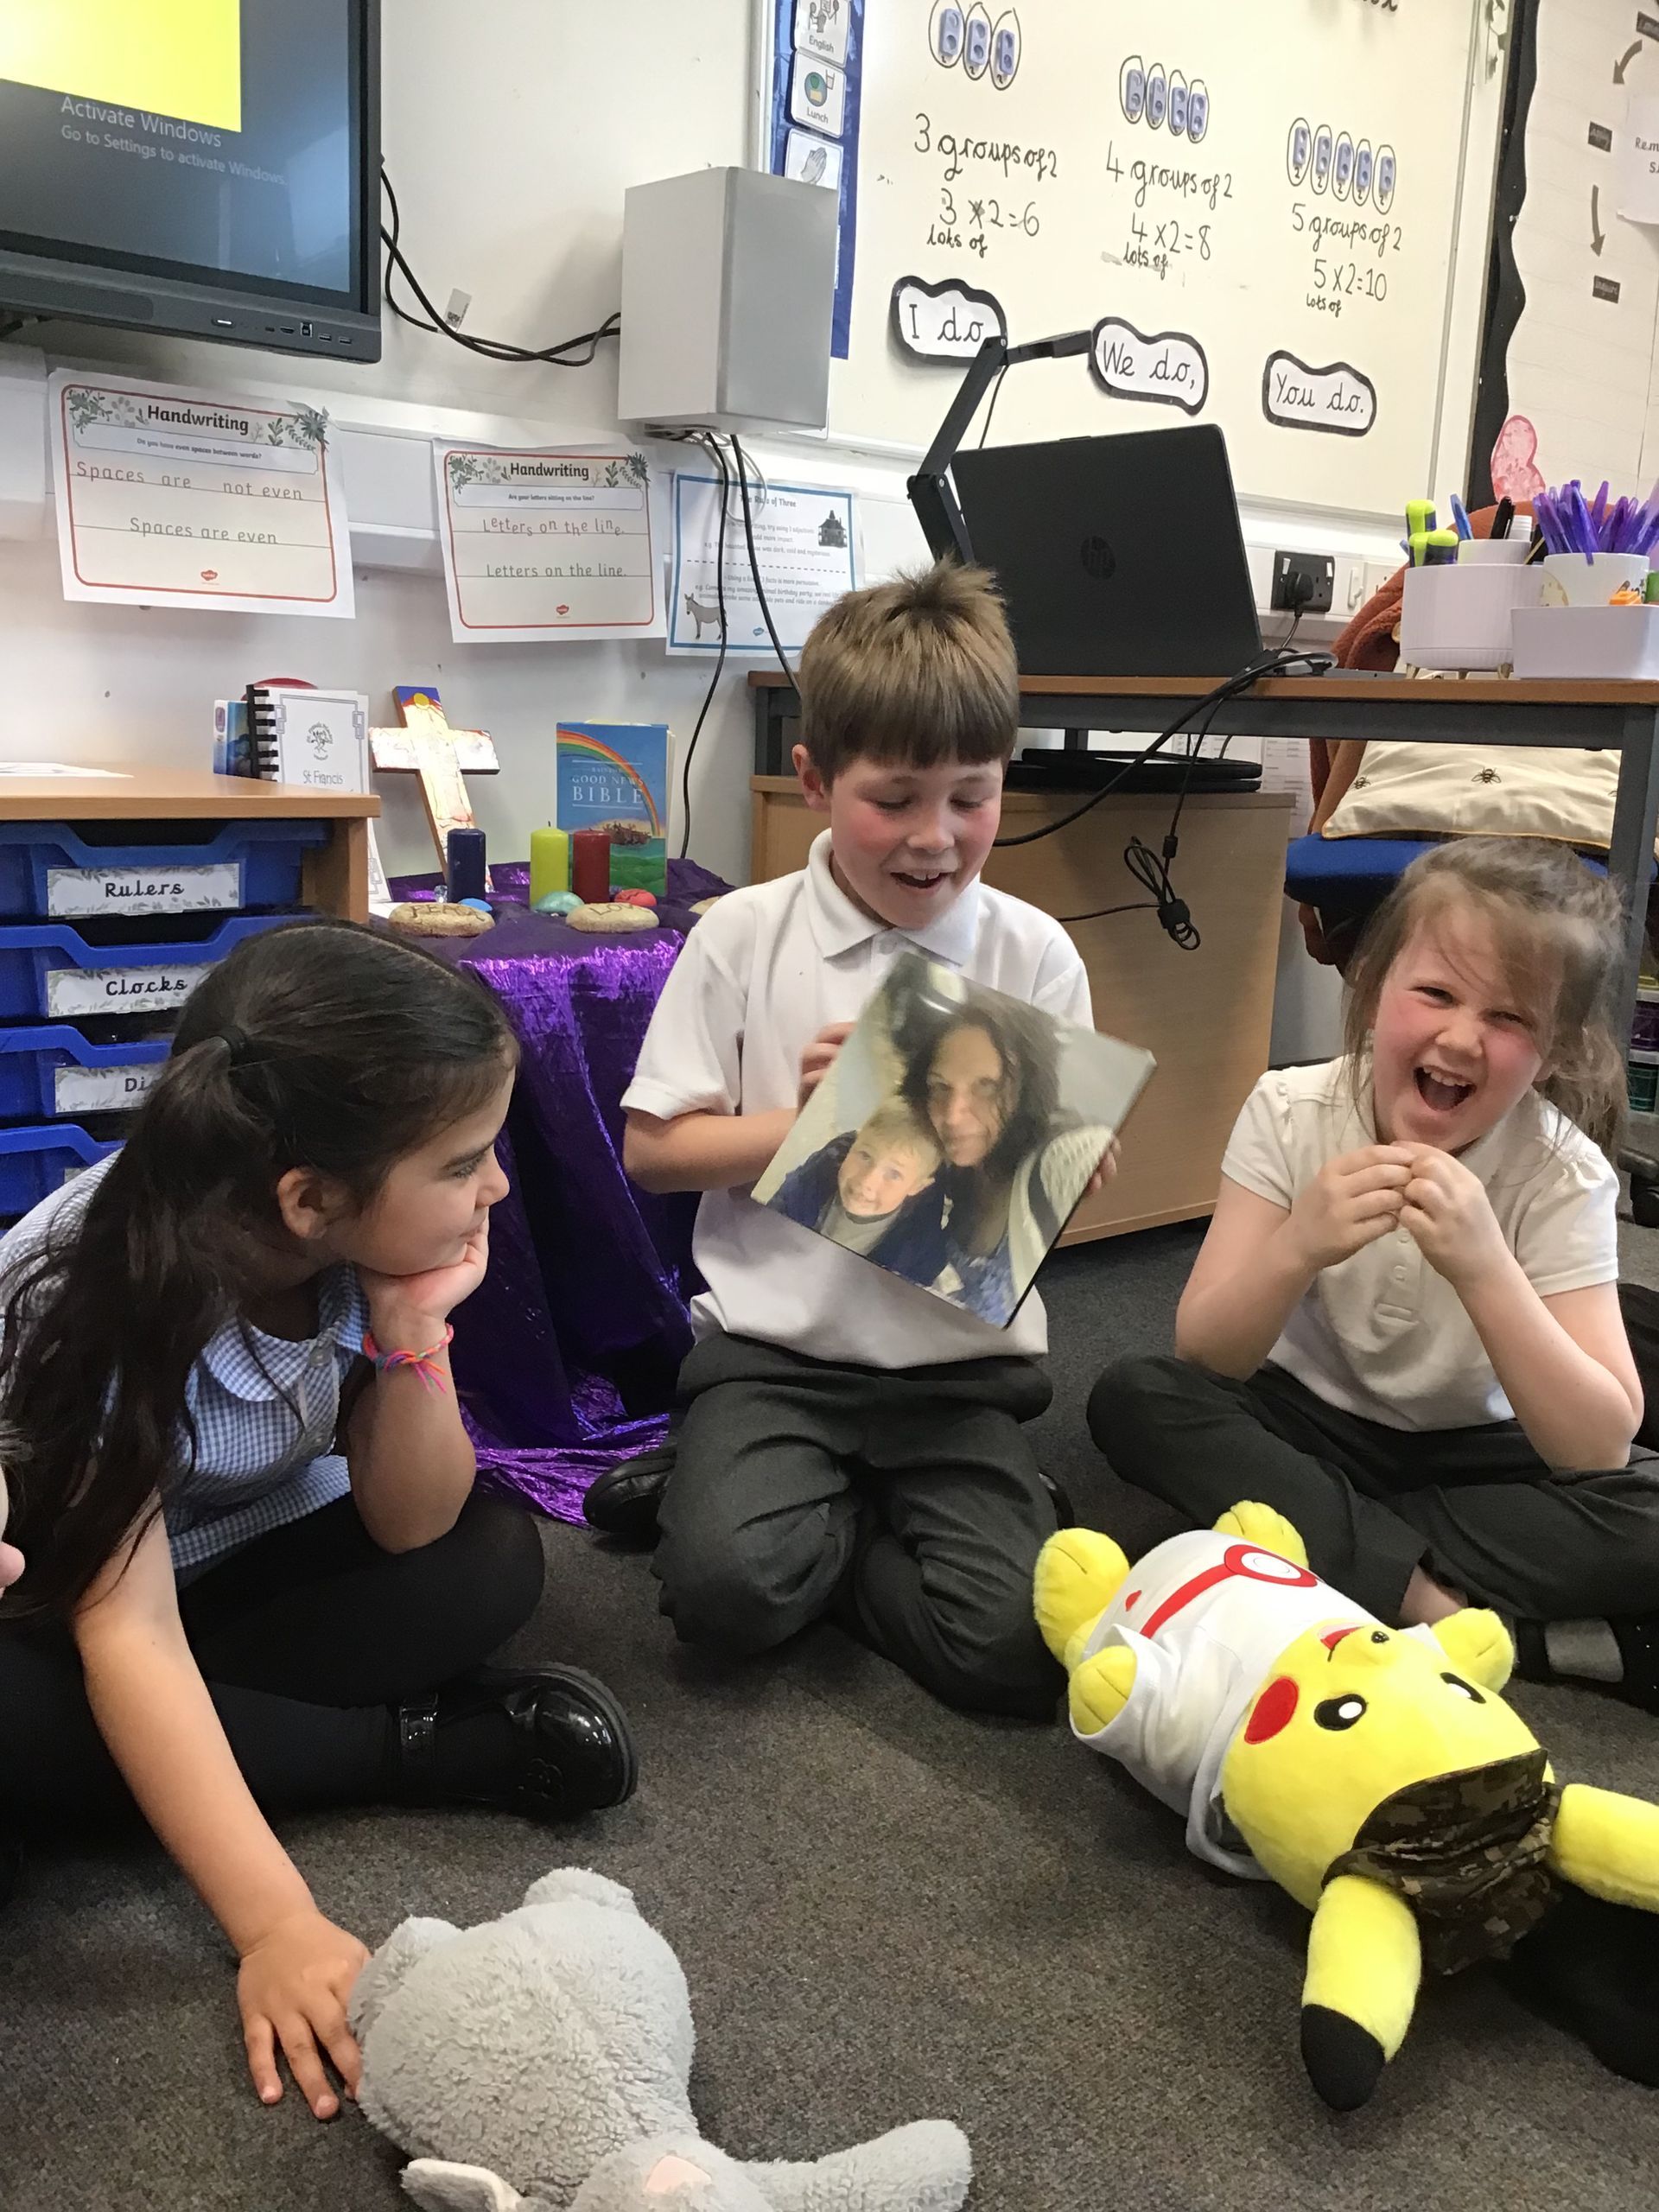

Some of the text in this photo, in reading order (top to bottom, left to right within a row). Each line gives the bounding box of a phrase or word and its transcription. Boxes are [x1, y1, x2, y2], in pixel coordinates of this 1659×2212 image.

[810, 35, 835, 54] English
[61, 96, 222, 148] Activate Windows
[807, 106, 830, 124] Lunch
[61, 125, 81, 141] Go
[86, 131, 100, 145] to
[104, 133, 156, 159] Settings
[161, 147, 174, 162] to
[178, 153, 226, 173] activate
[914, 113, 931, 153] 3
[938, 135, 1021, 181] groups
[1107, 140, 1233, 211] 4 groups of 2
[1292, 203, 1402, 258] 5 groups of 2
[969, 234, 988, 258] of
[1123, 242, 1169, 281] lots of
[1306, 293, 1342, 318] lots of
[908, 303, 983, 343] I do
[1103, 340, 1135, 377] We
[1276, 372, 1363, 414] You do.
[148, 405, 250, 436] Handwriting
[78, 461, 303, 501] Spaces are not even
[511, 462, 589, 481] Handwriting
[779, 498, 797, 508] Three
[130, 518, 278, 545] Spaces are even
[483, 518, 533, 537] Letters
[540, 519, 558, 534] on
[564, 521, 588, 537] the
[486, 563, 627, 578] Letters on the line.
[302, 770, 344, 785] St Francis
[572, 774, 644, 785] GOOD NEWS
[573, 786, 644, 804] BIBLE
[105, 880, 185, 899] Rulers
[105, 976, 188, 996] Clocks
